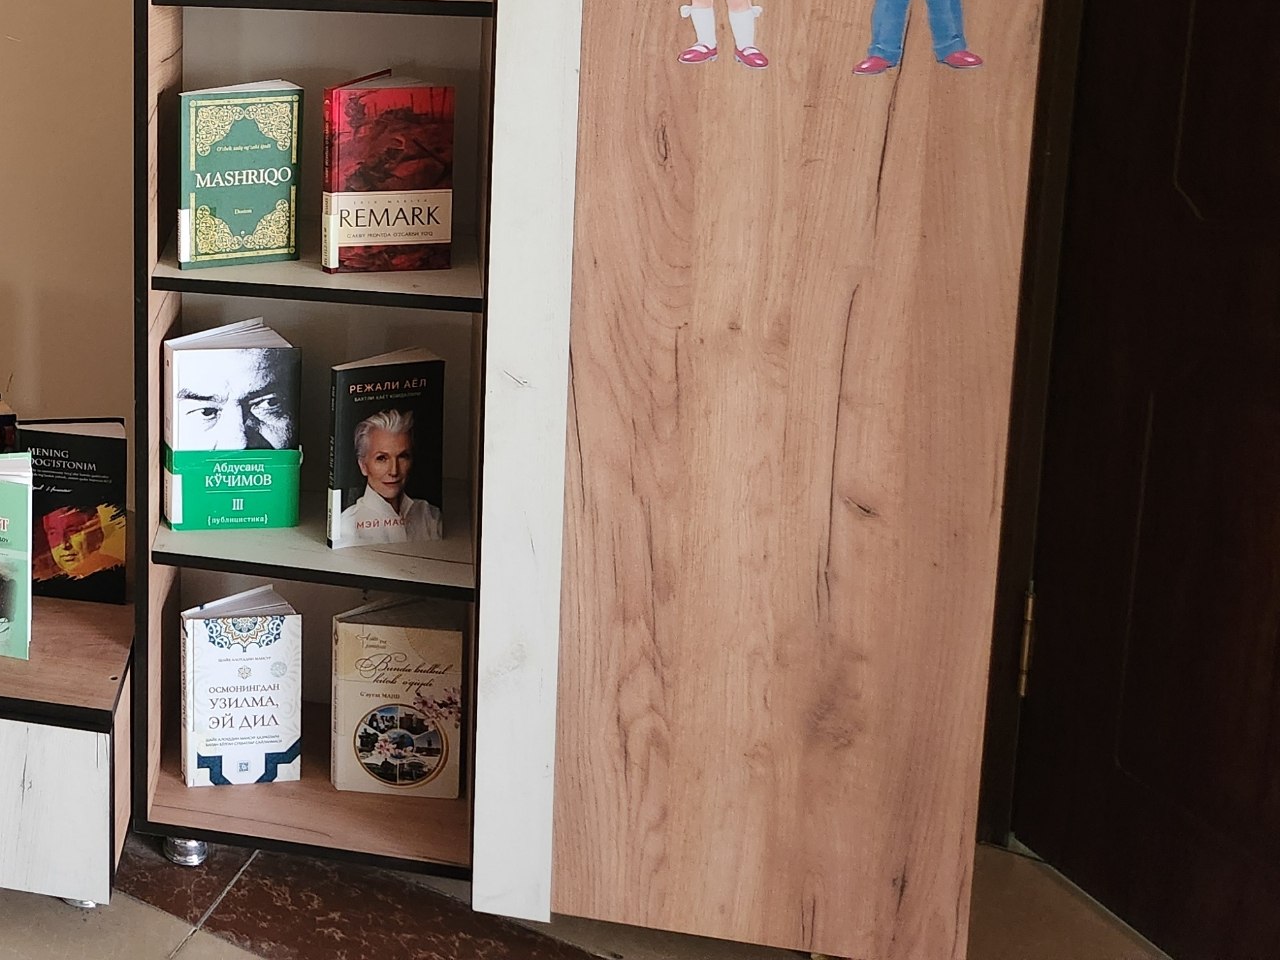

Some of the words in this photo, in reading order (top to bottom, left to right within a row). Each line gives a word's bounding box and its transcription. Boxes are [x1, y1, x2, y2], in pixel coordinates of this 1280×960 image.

[195, 167, 291, 189] MASHRIQO
[339, 206, 441, 228] REMARK
[349, 382, 399, 394] РЕЖАЛИ
[404, 378, 427, 389] АЁЛ
[27, 447, 69, 459] MENING
[213, 462, 264, 474] Абдусаид
[205, 474, 272, 487] КЎЧИМОВ
[232, 499, 244, 511] III
[356, 520, 380, 529] МЭЙ
[208, 684, 280, 693] ОСМОНИНГДАН
[209, 696, 279, 709] УЗИЛМА,
[209, 714, 234, 729] ЭЙ
[239, 714, 279, 729] ДИЛ
